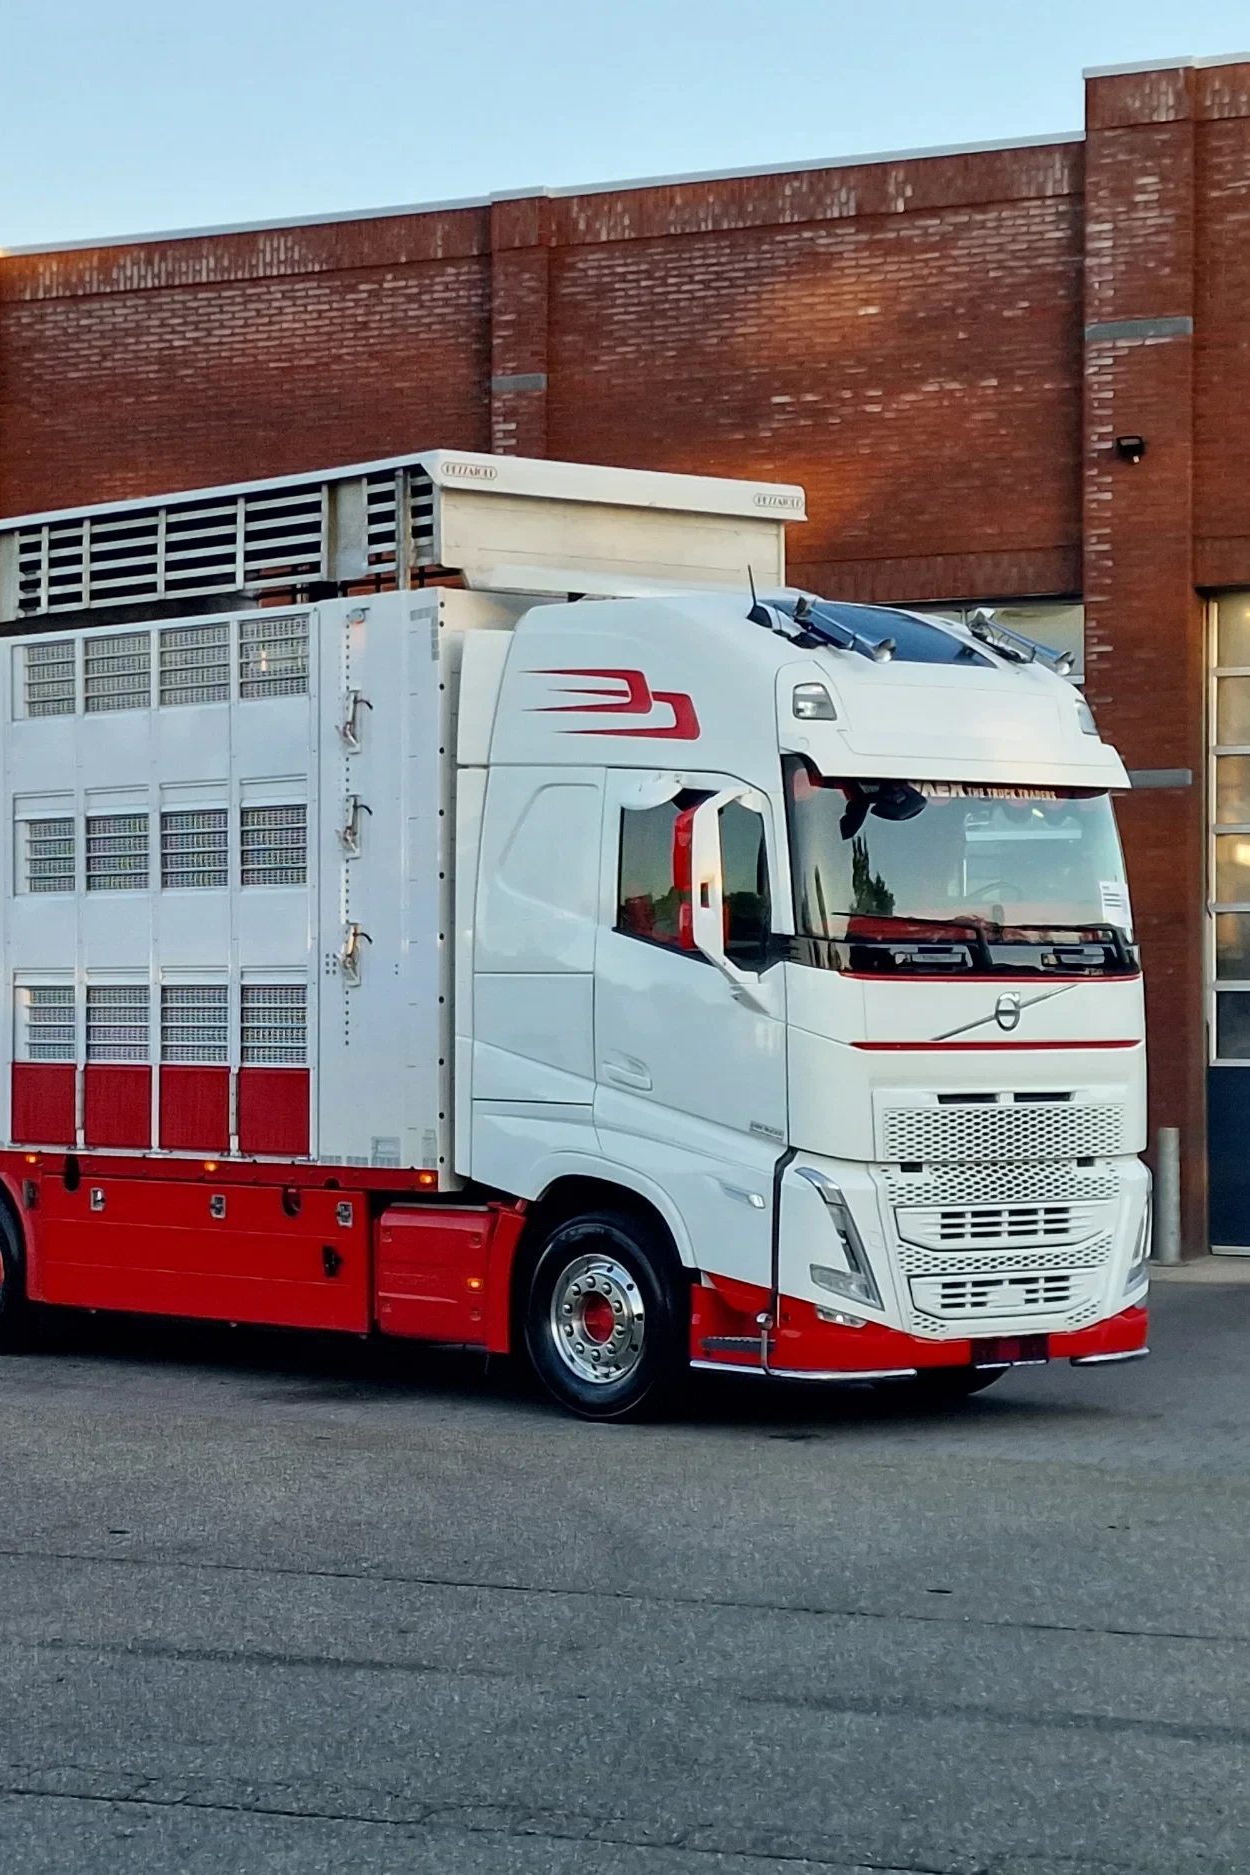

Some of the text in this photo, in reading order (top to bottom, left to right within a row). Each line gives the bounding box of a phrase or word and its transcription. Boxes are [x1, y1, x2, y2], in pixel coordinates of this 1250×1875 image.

[967, 787, 986, 798] THE
[986, 788, 1017, 799] TRUCK
[1015, 789, 1057, 801] TRADERS
